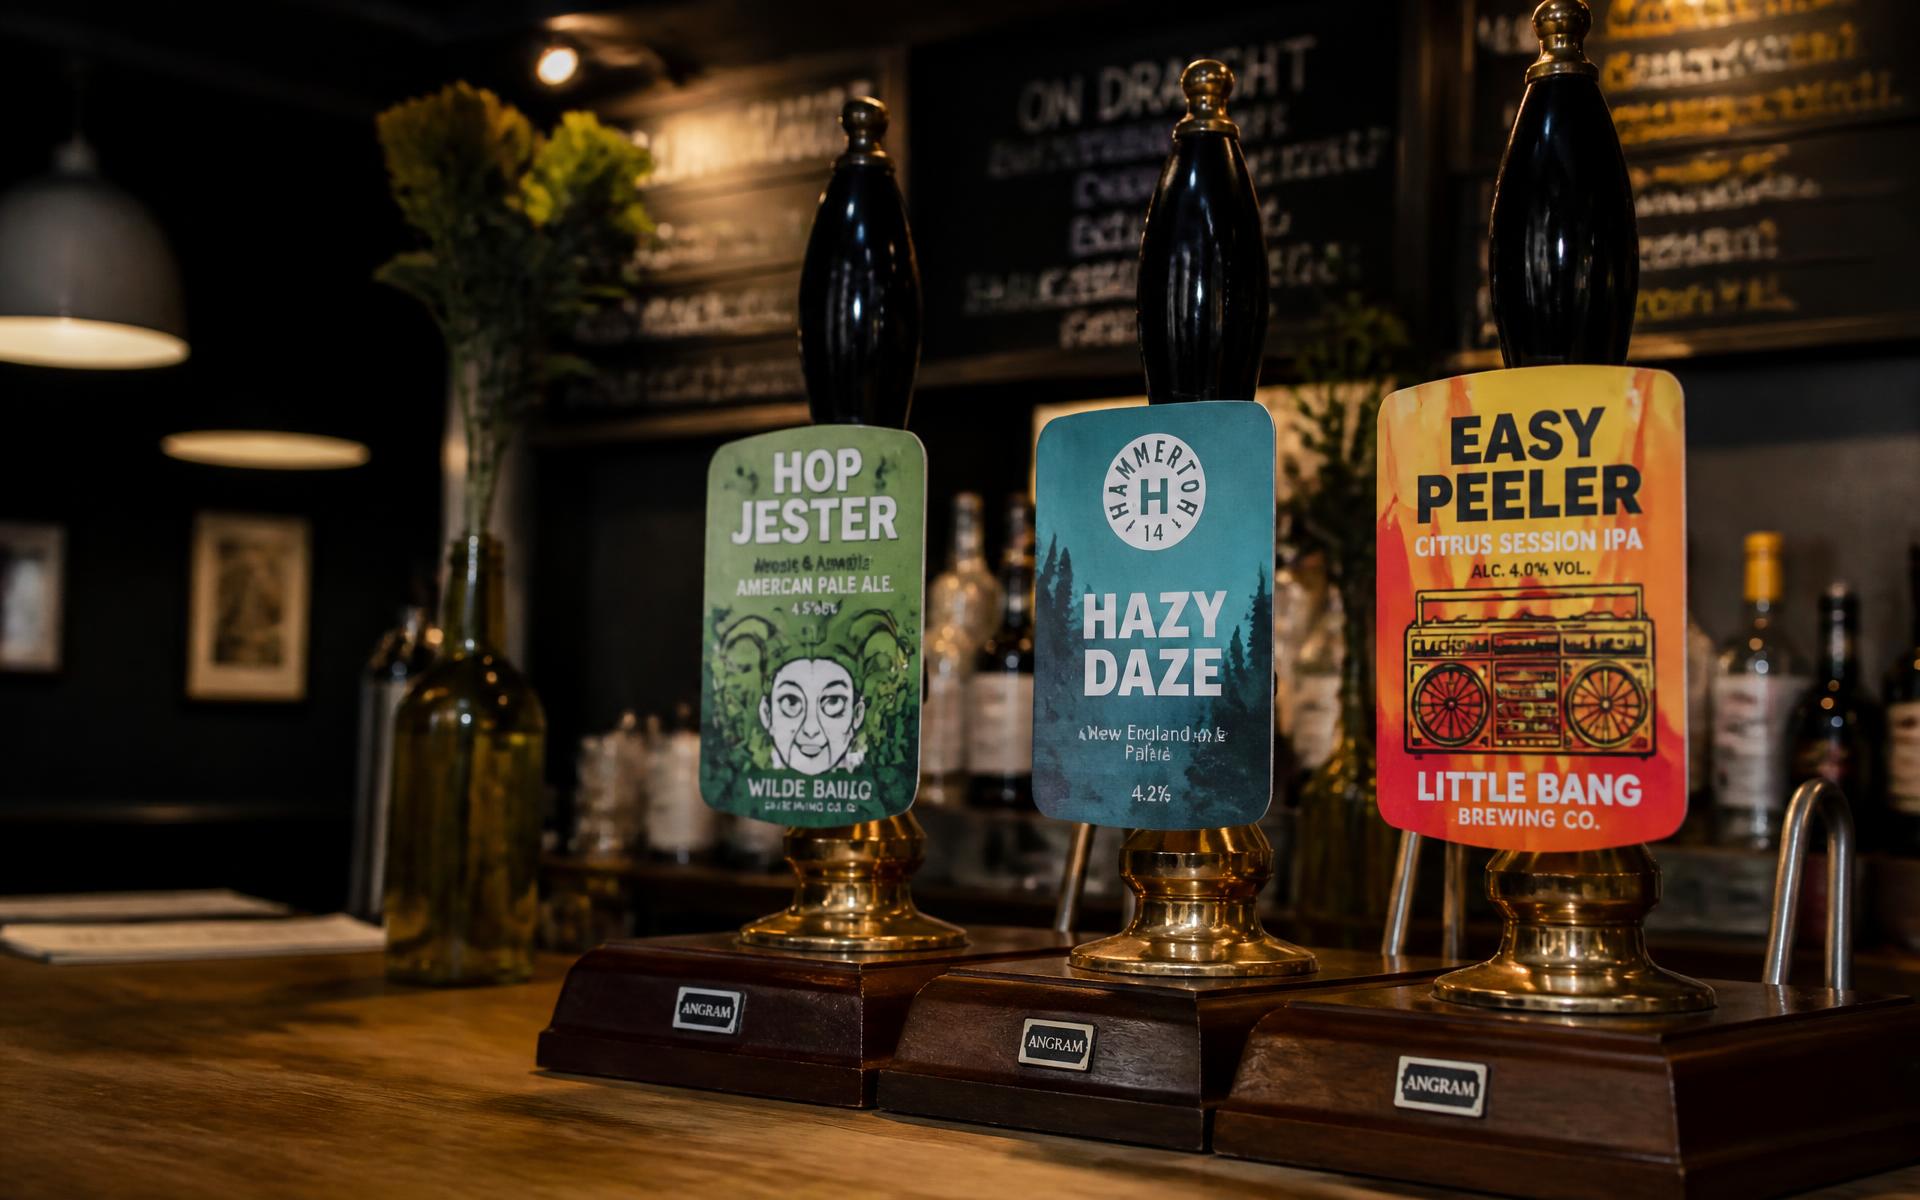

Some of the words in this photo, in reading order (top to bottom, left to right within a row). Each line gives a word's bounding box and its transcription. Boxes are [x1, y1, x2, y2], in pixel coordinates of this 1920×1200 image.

[1017, 75, 1083, 133] ON
[1097, 36, 1316, 122] DRAHT
[1450, 407, 1606, 466] EASY
[773, 448, 862, 494] HOP
[1140, 478, 1168, 515] H
[1417, 463, 1643, 524] PEELER
[731, 496, 898, 544] JESTER
[1144, 523, 1163, 542] 14
[1415, 534, 1492, 557] CITRUS
[1500, 530, 1597, 554] SESSION
[1604, 527, 1644, 550] IPA
[818, 576, 857, 594] PALE
[861, 575, 894, 593] ALE.
[1472, 564, 1505, 579] ALC.
[1509, 562, 1548, 578] 4.0%
[1554, 561, 1591, 576] VOL.
[1083, 590, 1227, 640] HAZY
[1084, 648, 1222, 696] DAZE
[747, 778, 806, 798] WILDE
[1417, 771, 1526, 803] LITTLE
[1537, 772, 1642, 807] BANG
[1457, 807, 1556, 829] BREWING
[1563, 809, 1600, 831] CO.
[681, 1002, 731, 1019] ANGRAM
[1028, 1034, 1084, 1053] ANGRAM
[1404, 1075, 1475, 1097] ANGRAM
